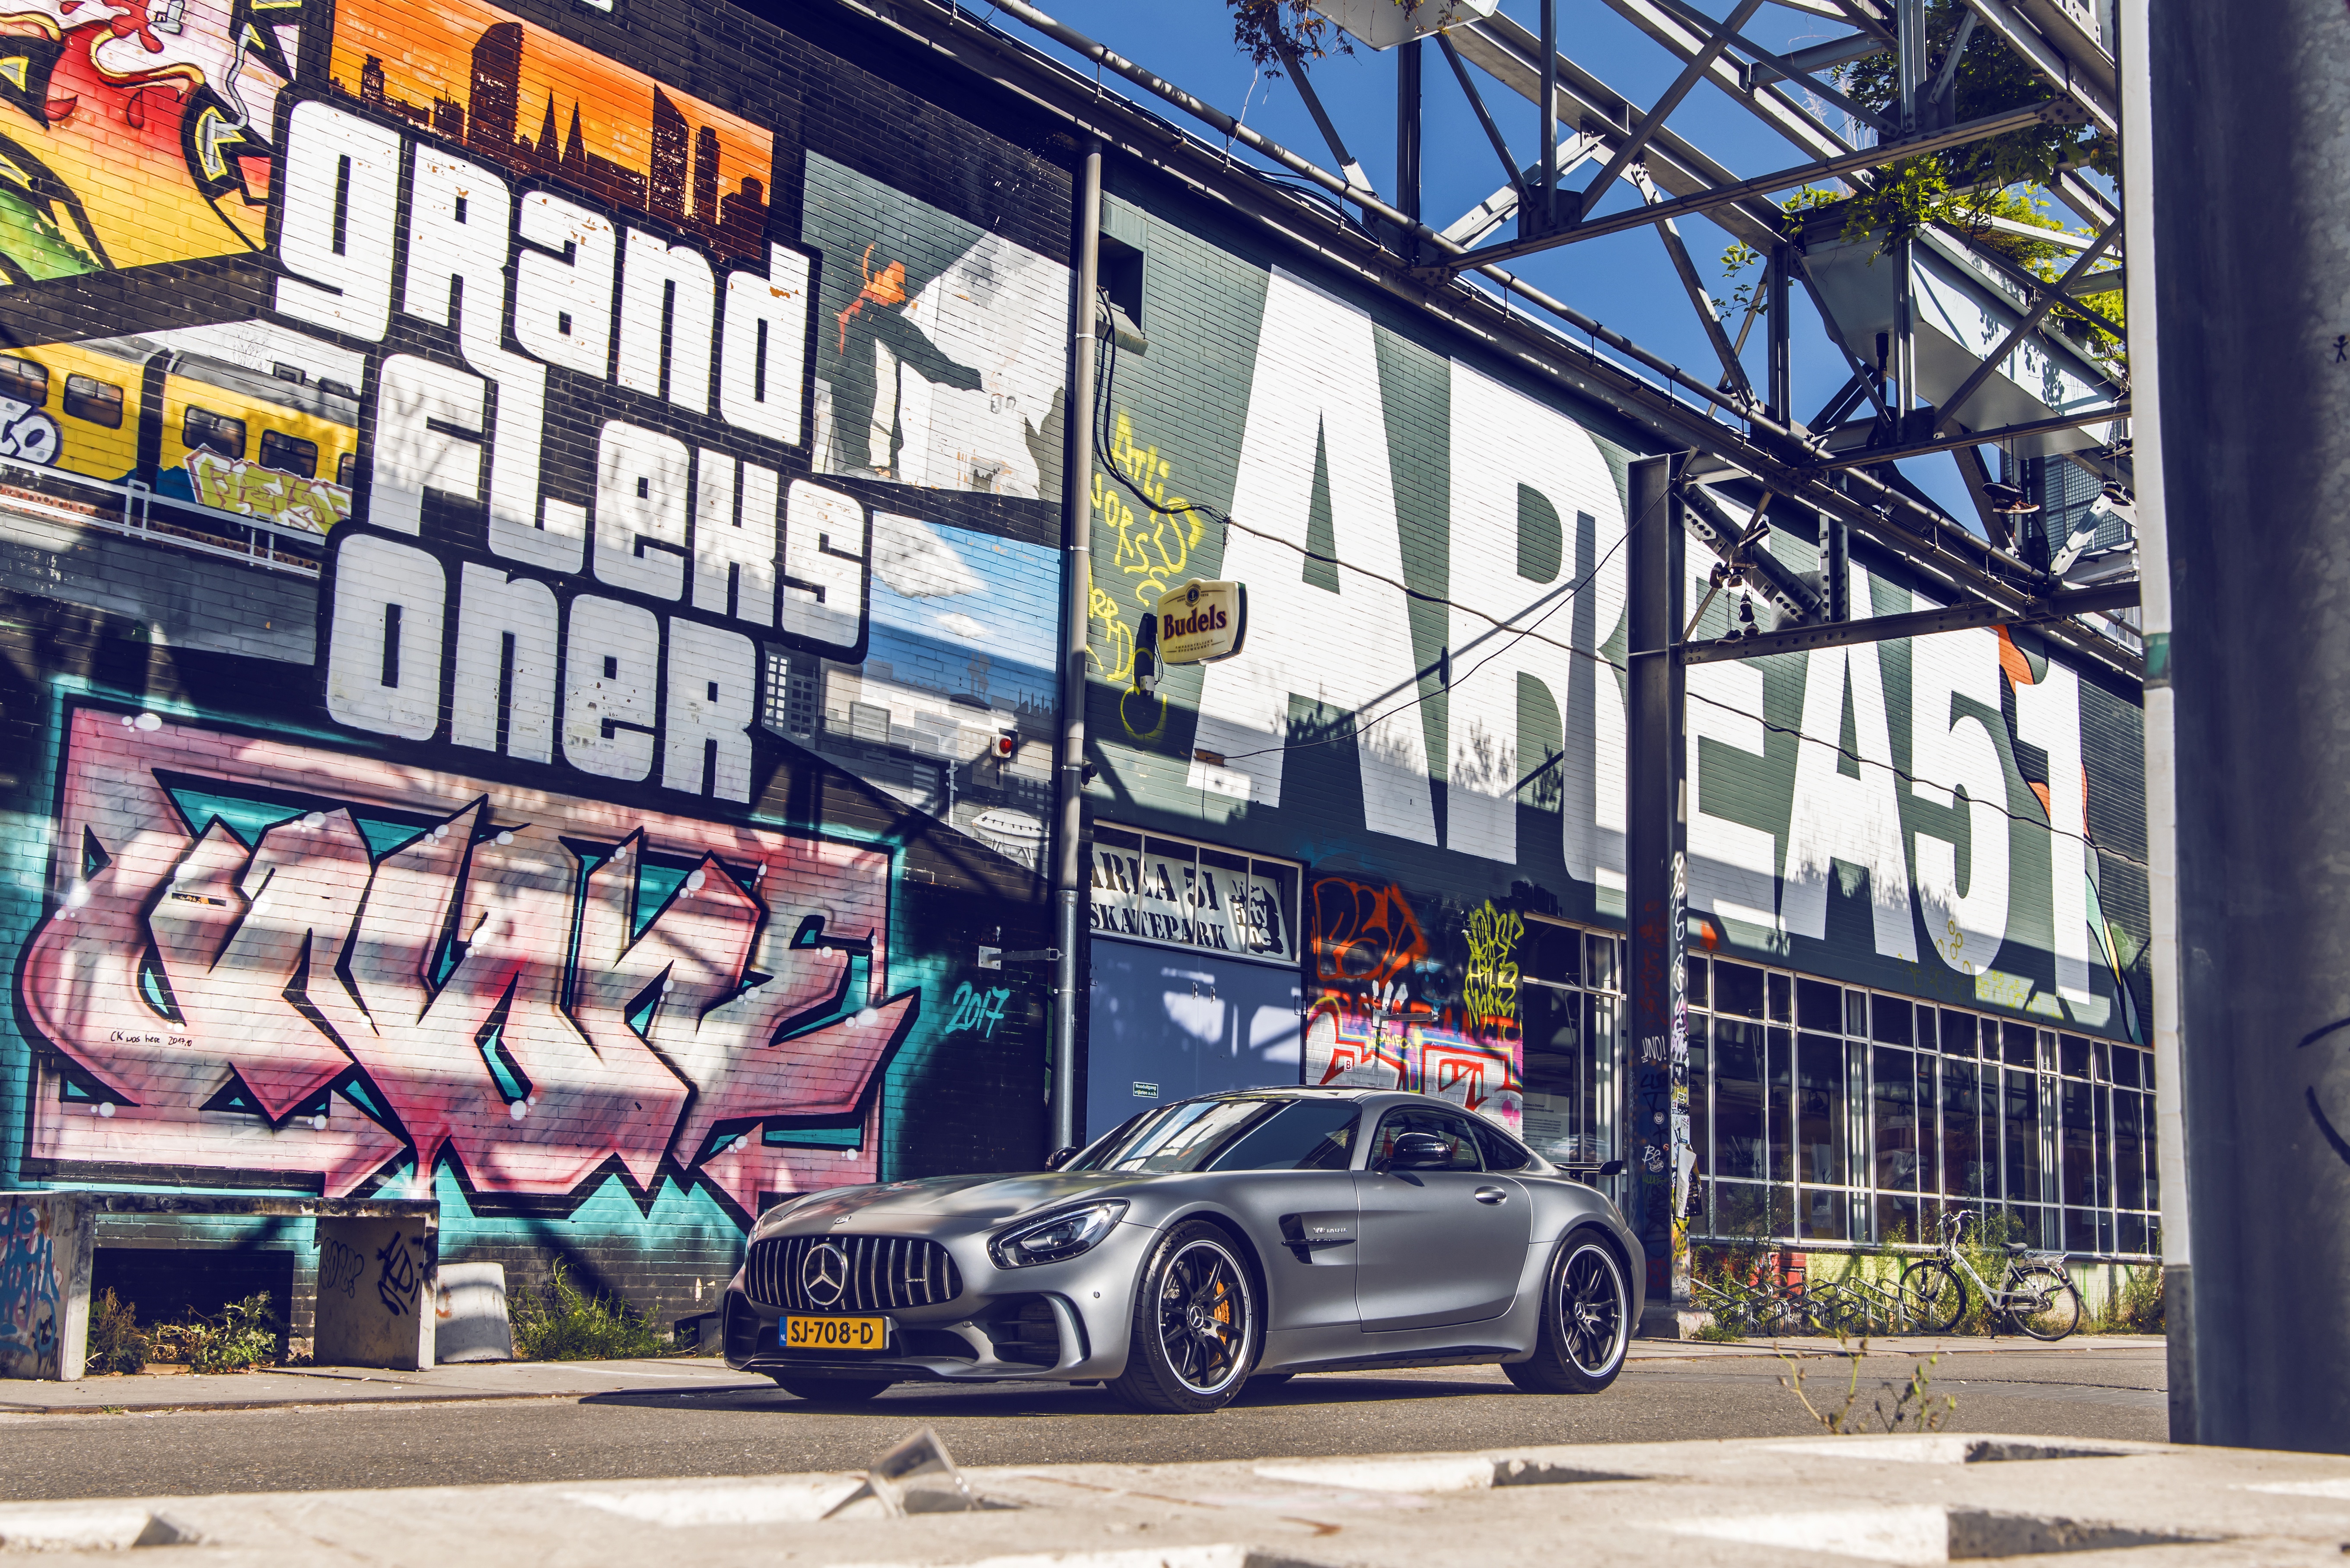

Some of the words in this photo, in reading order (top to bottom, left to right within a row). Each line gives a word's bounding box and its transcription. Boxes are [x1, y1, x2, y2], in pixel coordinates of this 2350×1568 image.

[1163, 604, 1227, 640] Budels
[1183, 866, 1220, 911] 51
[945, 980, 1010, 1038] 2017
[111, 1030, 125, 1042] CK
[145, 1034, 160, 1043] here
[1346, 1060, 1351, 1069] B
[791, 1320, 873, 1344] SJ-708-D
